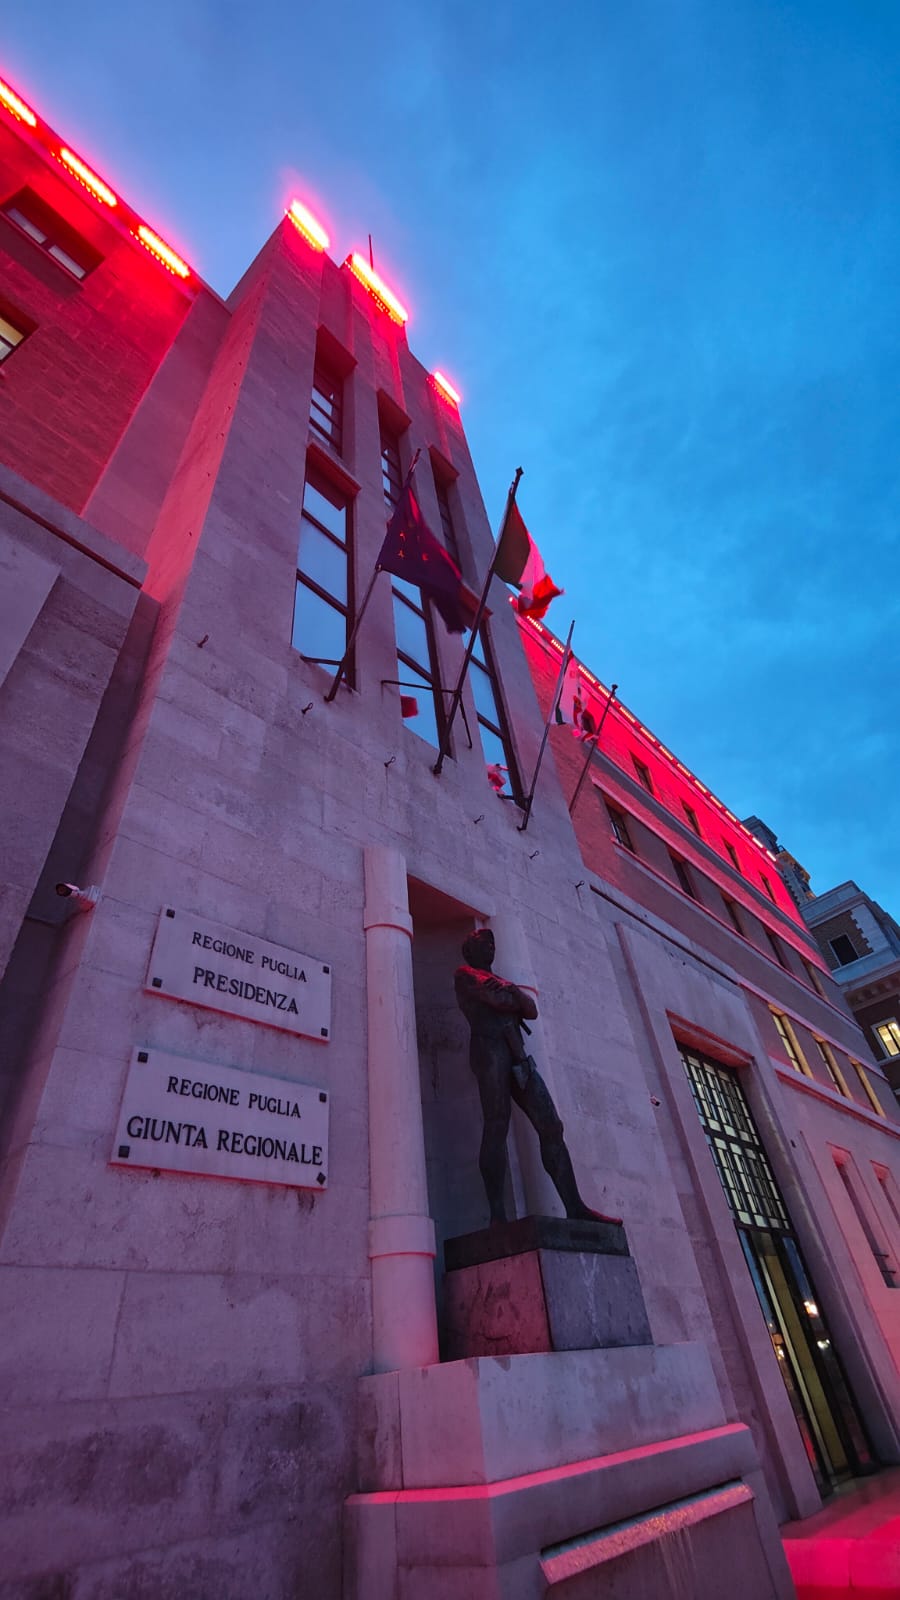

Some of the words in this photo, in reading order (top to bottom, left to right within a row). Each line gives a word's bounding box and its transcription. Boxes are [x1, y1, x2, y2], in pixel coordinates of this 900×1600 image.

[192, 931, 254, 964] REGIONE
[261, 955, 307, 982] PUGLIA
[193, 966, 299, 1015] PRESIDENZA
[166, 1076, 240, 1106] REGIONE
[248, 1093, 301, 1118] PUGLIA
[127, 1116, 208, 1149] GIUNTA
[217, 1130, 323, 1166] REGIONALE
